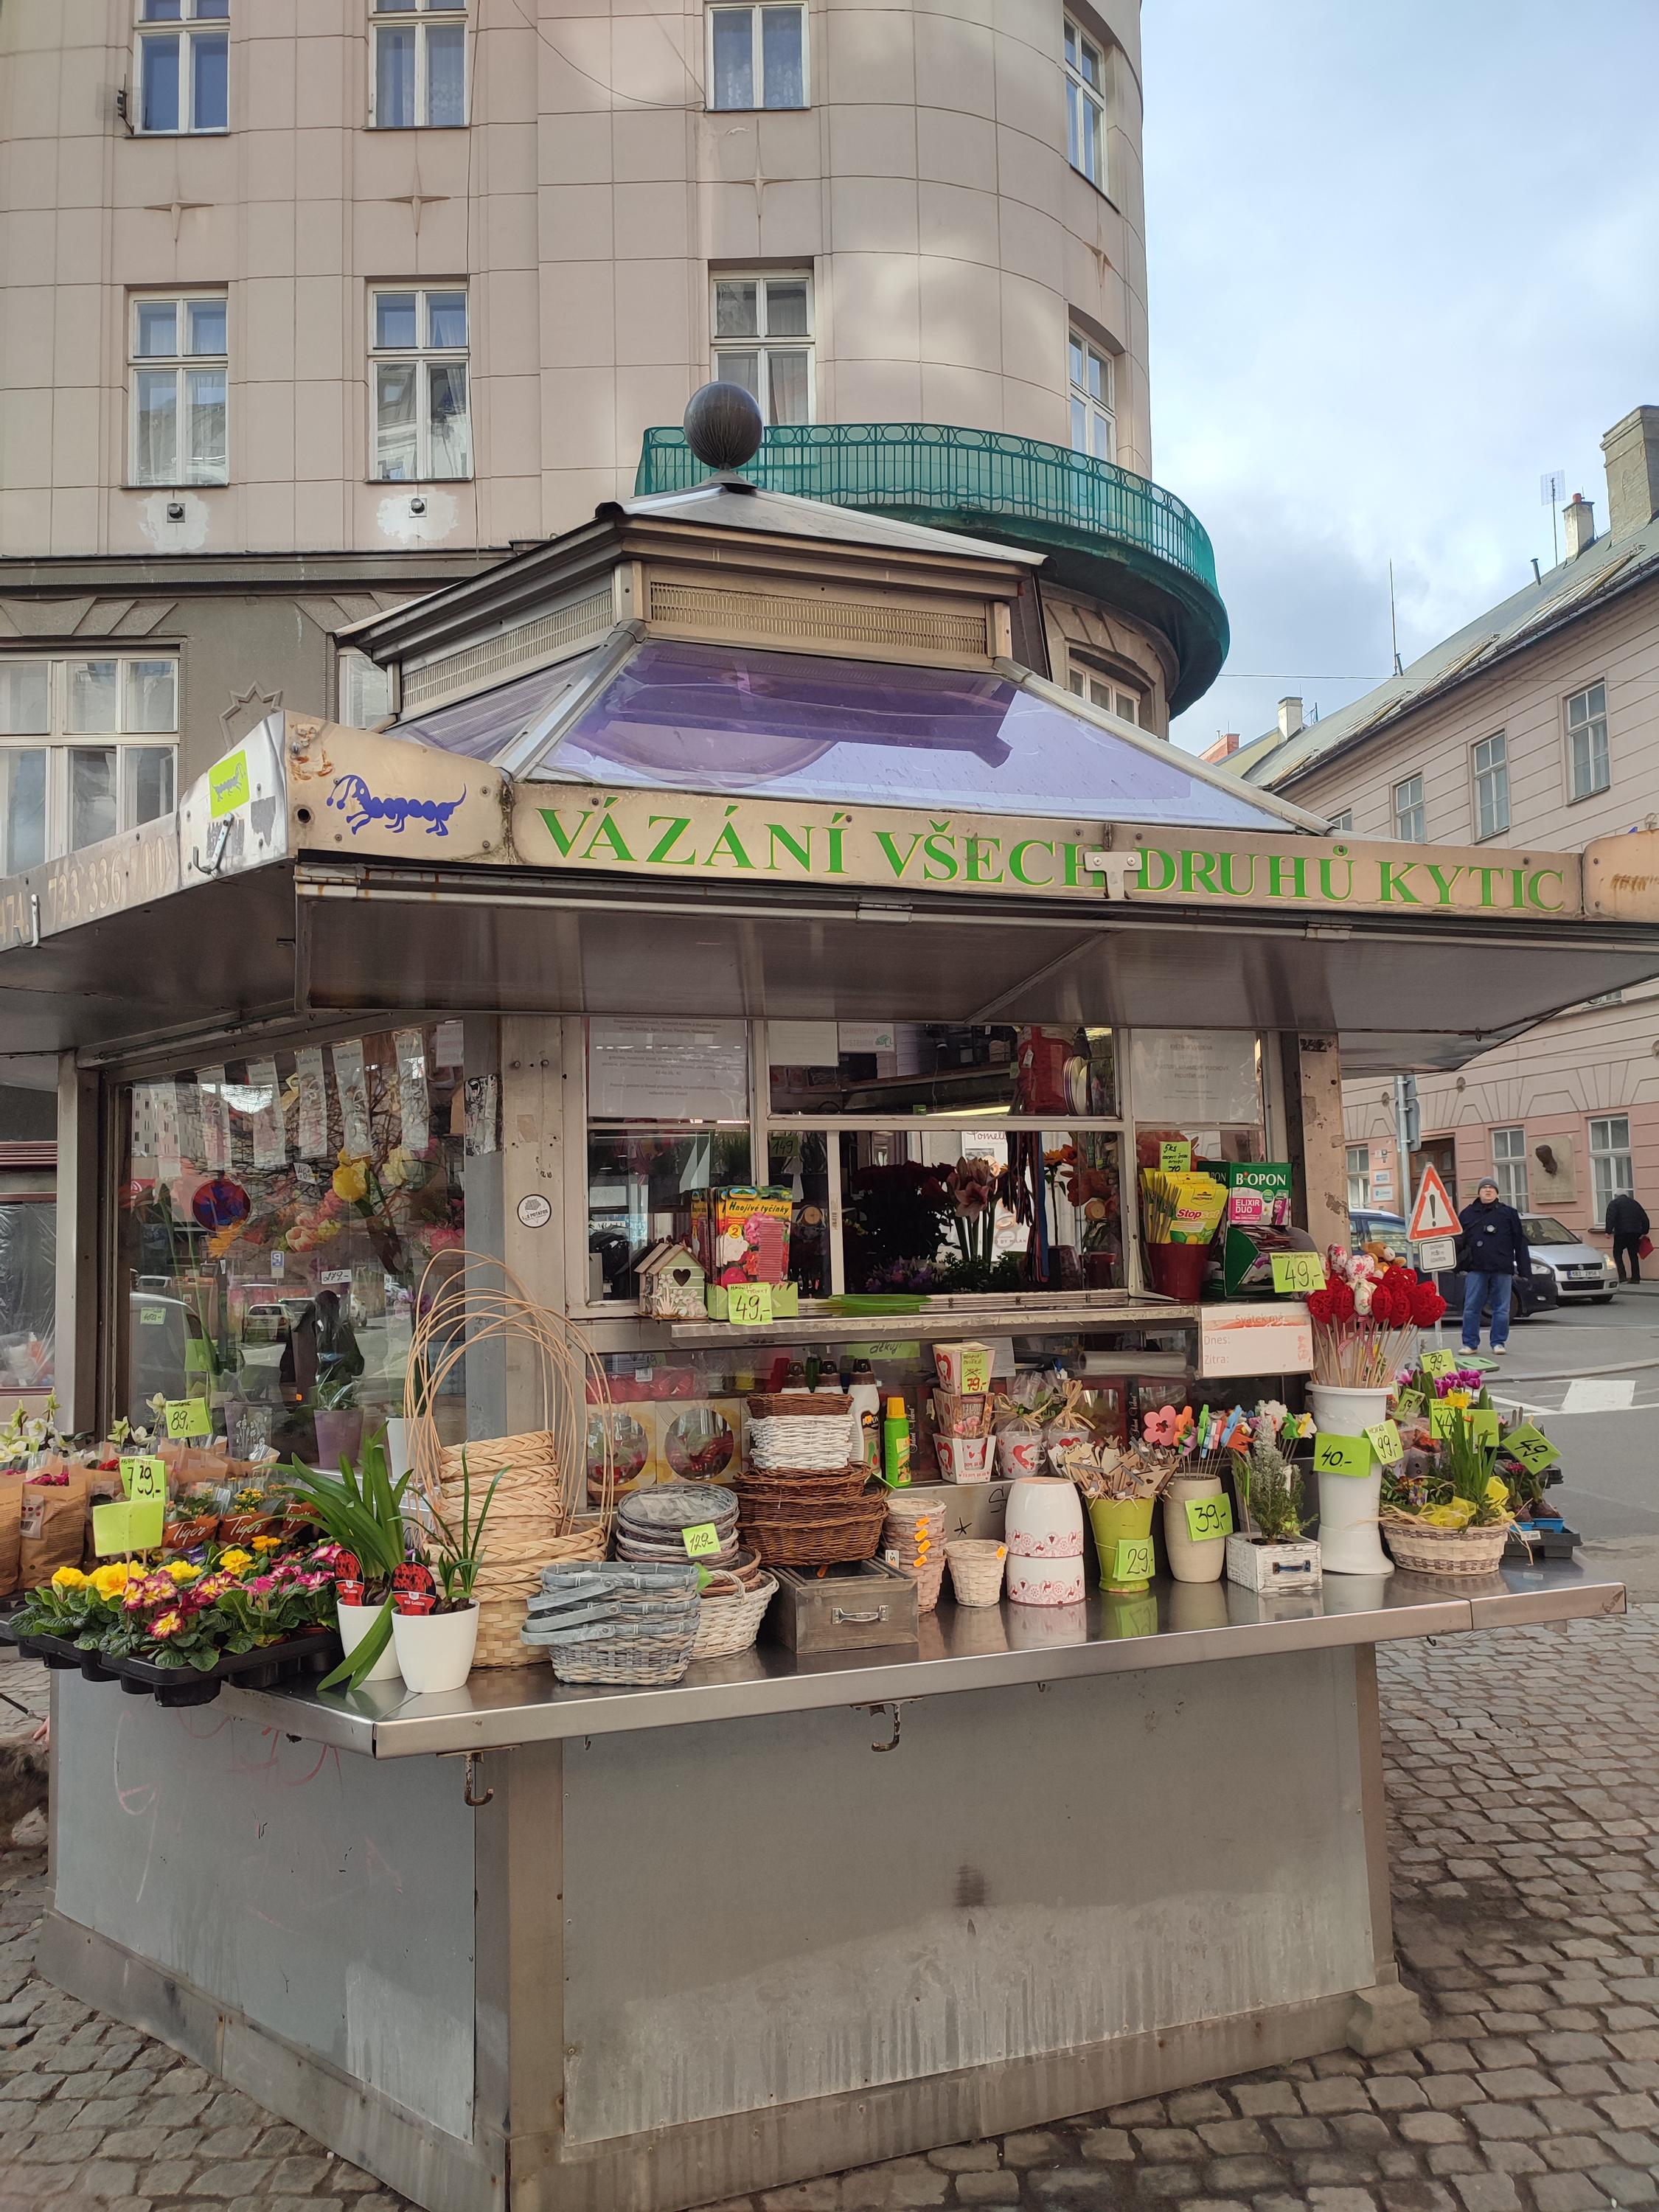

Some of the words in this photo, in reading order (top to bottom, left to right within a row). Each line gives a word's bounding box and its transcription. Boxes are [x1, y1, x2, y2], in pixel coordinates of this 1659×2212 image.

[535, 796, 849, 875] VÁZÁNÍ
[872, 818, 1106, 888] VŠECH
[1133, 844, 1355, 902] DRUHŮ
[1375, 860, 1567, 913] KYTIC
[729, 1201, 759, 1213] Hnojivé
[760, 1203, 790, 1215] tyčinky
[1177, 1208, 1221, 1220] Stopset
[1236, 1199, 1260, 1207] ELIXIR
[731, 1227, 739, 1237] 2
[1285, 1261, 1321, 1290] 49,-
[736, 1295, 771, 1321] 49,-
[1204, 1335, 1231, 1345] Dnes:
[1204, 1354, 1229, 1365] Zítra:
[171, 1411, 195, 1430] 89,-
[225, 1515, 265, 1541] Tiger
[1194, 1504, 1226, 1532] 39,-
[168, 1520, 209, 1545] Tiger
[1127, 1548, 1153, 1575] 29,-
